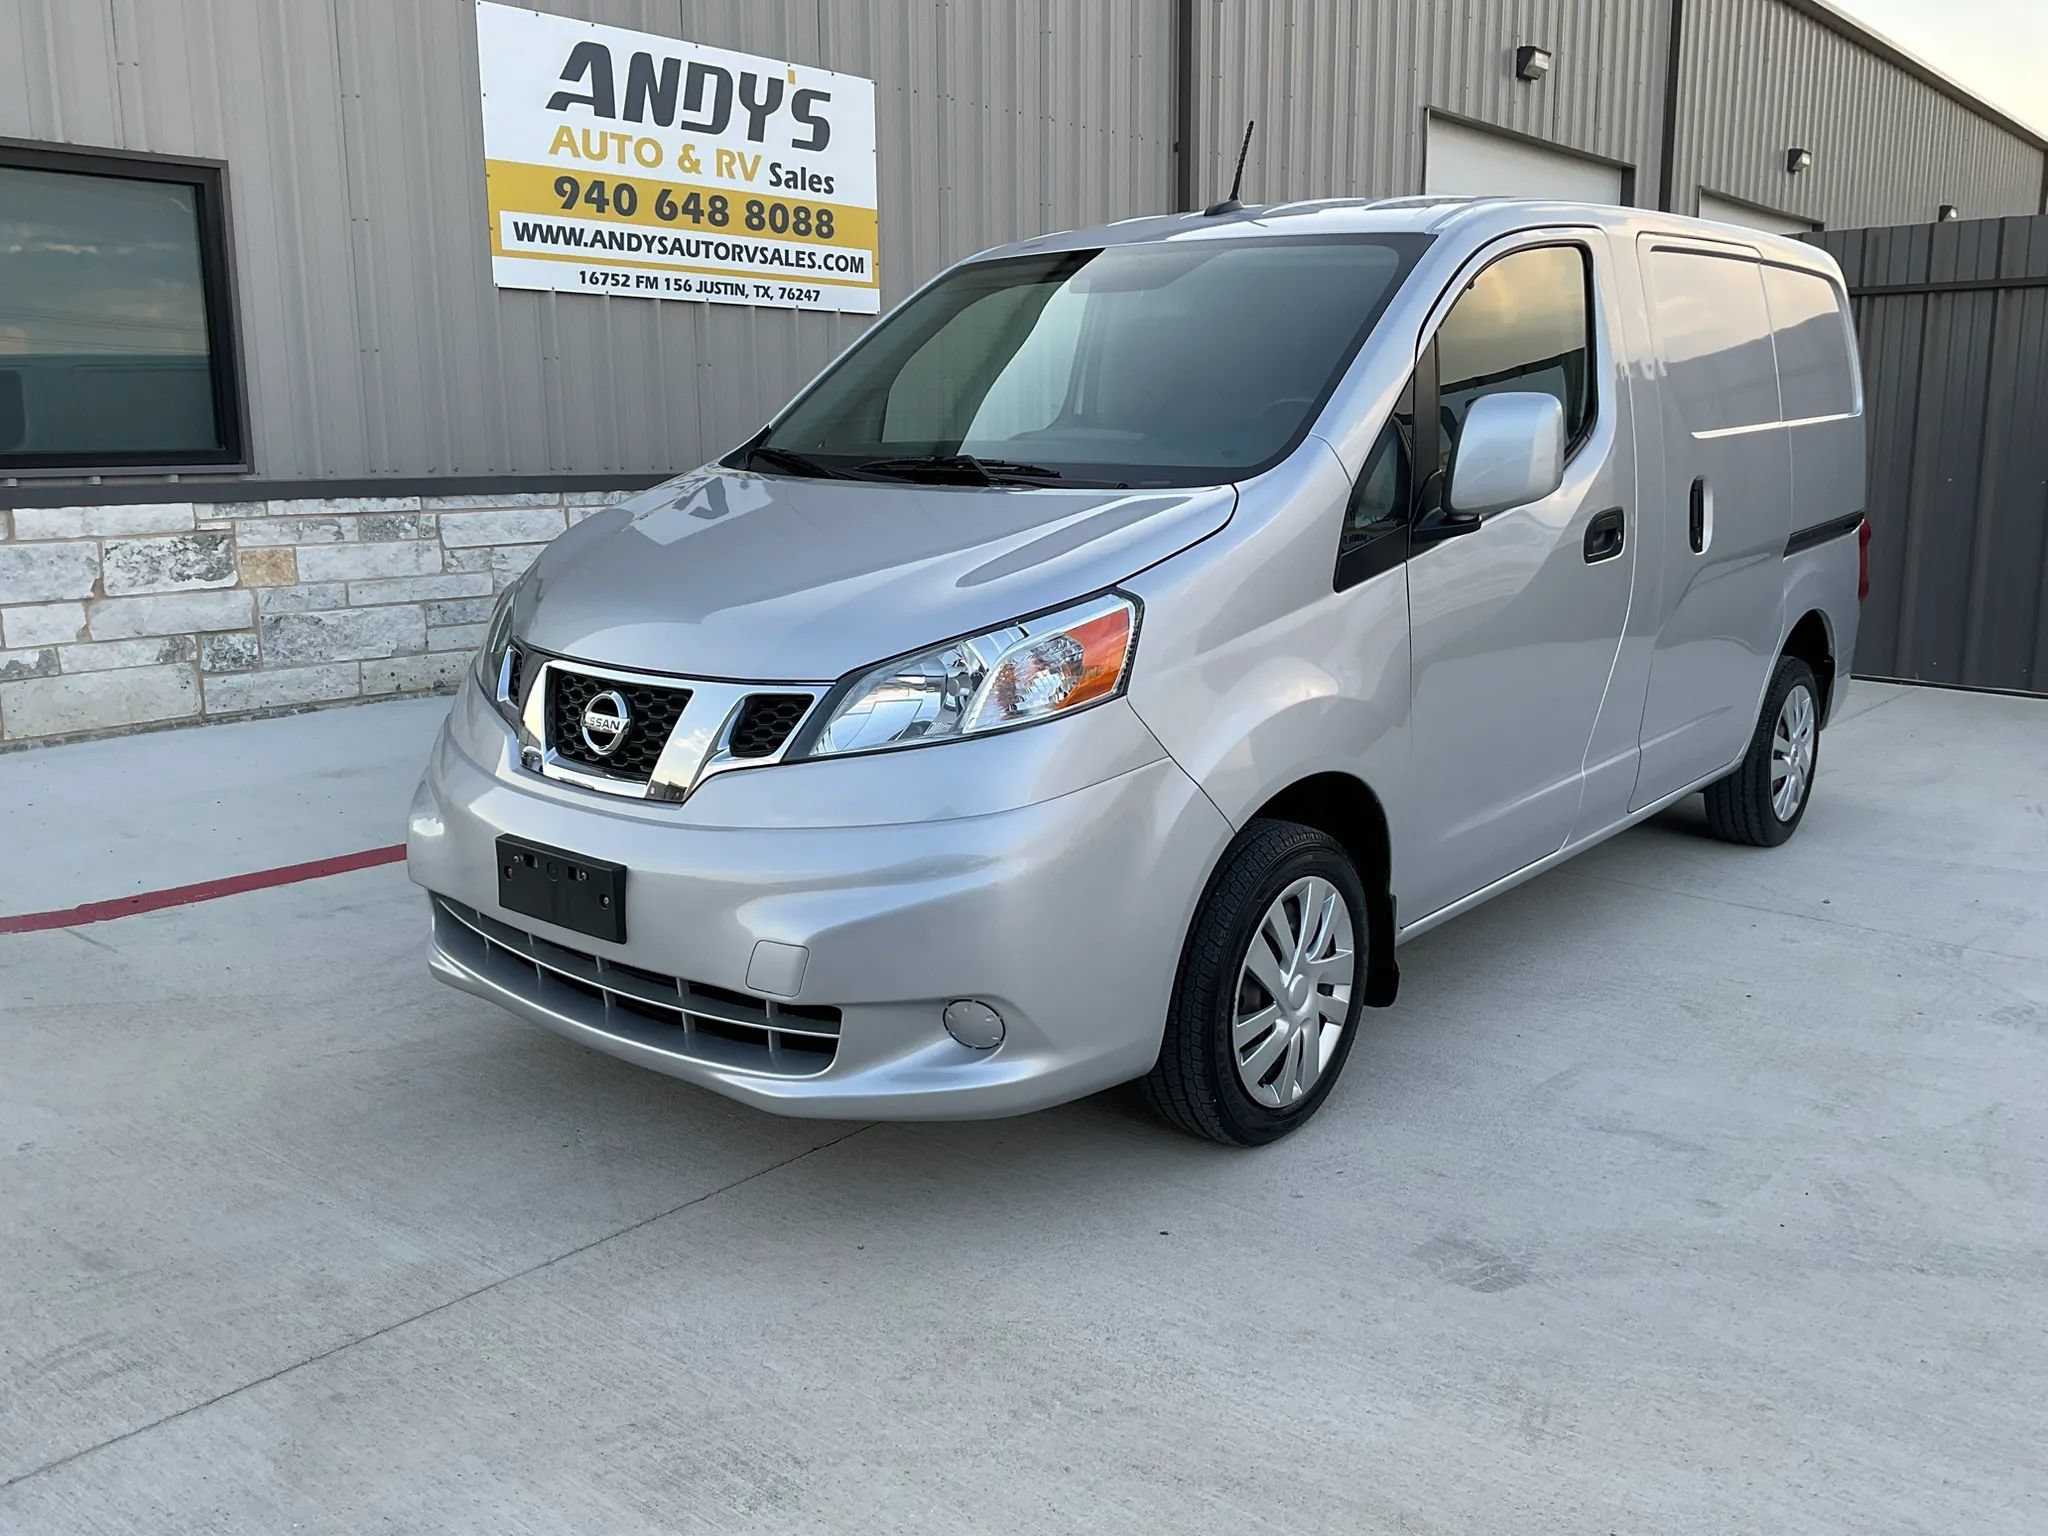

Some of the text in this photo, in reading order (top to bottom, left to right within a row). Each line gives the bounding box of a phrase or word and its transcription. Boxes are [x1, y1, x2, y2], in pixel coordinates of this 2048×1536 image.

[545, 40, 832, 152] ANDY'S
[548, 125, 835, 195] AUTO & RV Sales
[554, 176, 834, 239] 940 648 8088
[513, 221, 864, 274] WWW.ANDYSAUTORVSALES.COM
[579, 270, 820, 302] 16752 FM 156 JUSTIN, TX, 76247
[585, 715, 621, 731] SSAN
